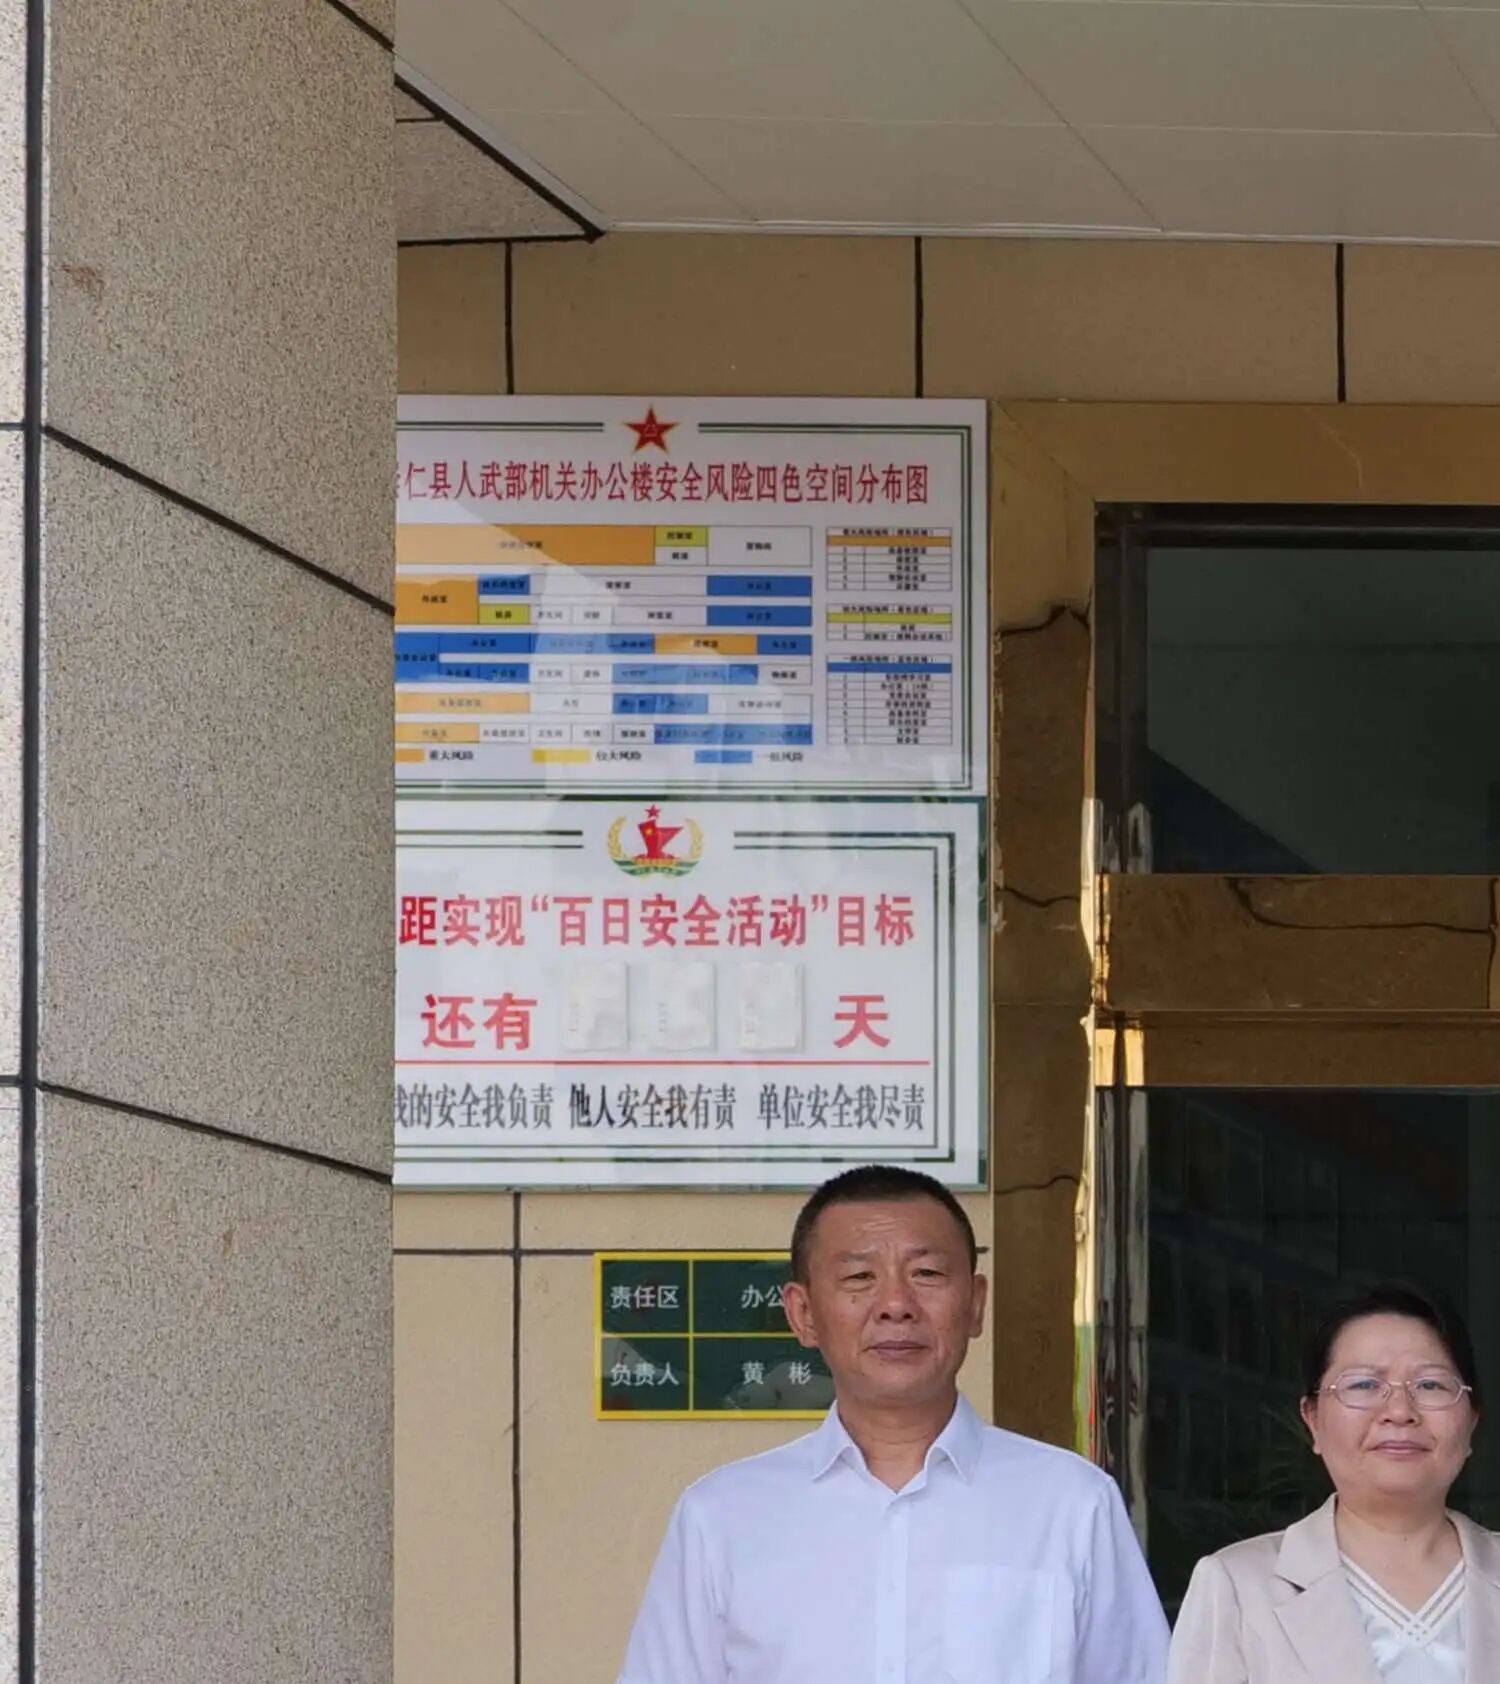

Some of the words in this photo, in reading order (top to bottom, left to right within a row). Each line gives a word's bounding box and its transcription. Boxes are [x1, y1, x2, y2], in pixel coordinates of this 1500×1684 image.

[396, 461, 930, 504] 仁县人武部机关办公楼安全风险四色空间分布图
[400, 894, 916, 948] 距实现“百日安全活动”目标
[421, 991, 539, 1050] 还有
[833, 994, 891, 1049] 天
[568, 1082, 737, 1130] 他人安全我有责
[757, 1083, 925, 1131] 单位安全我尽责
[610, 1285, 680, 1309] 责任区
[610, 1362, 680, 1386] 负责人
